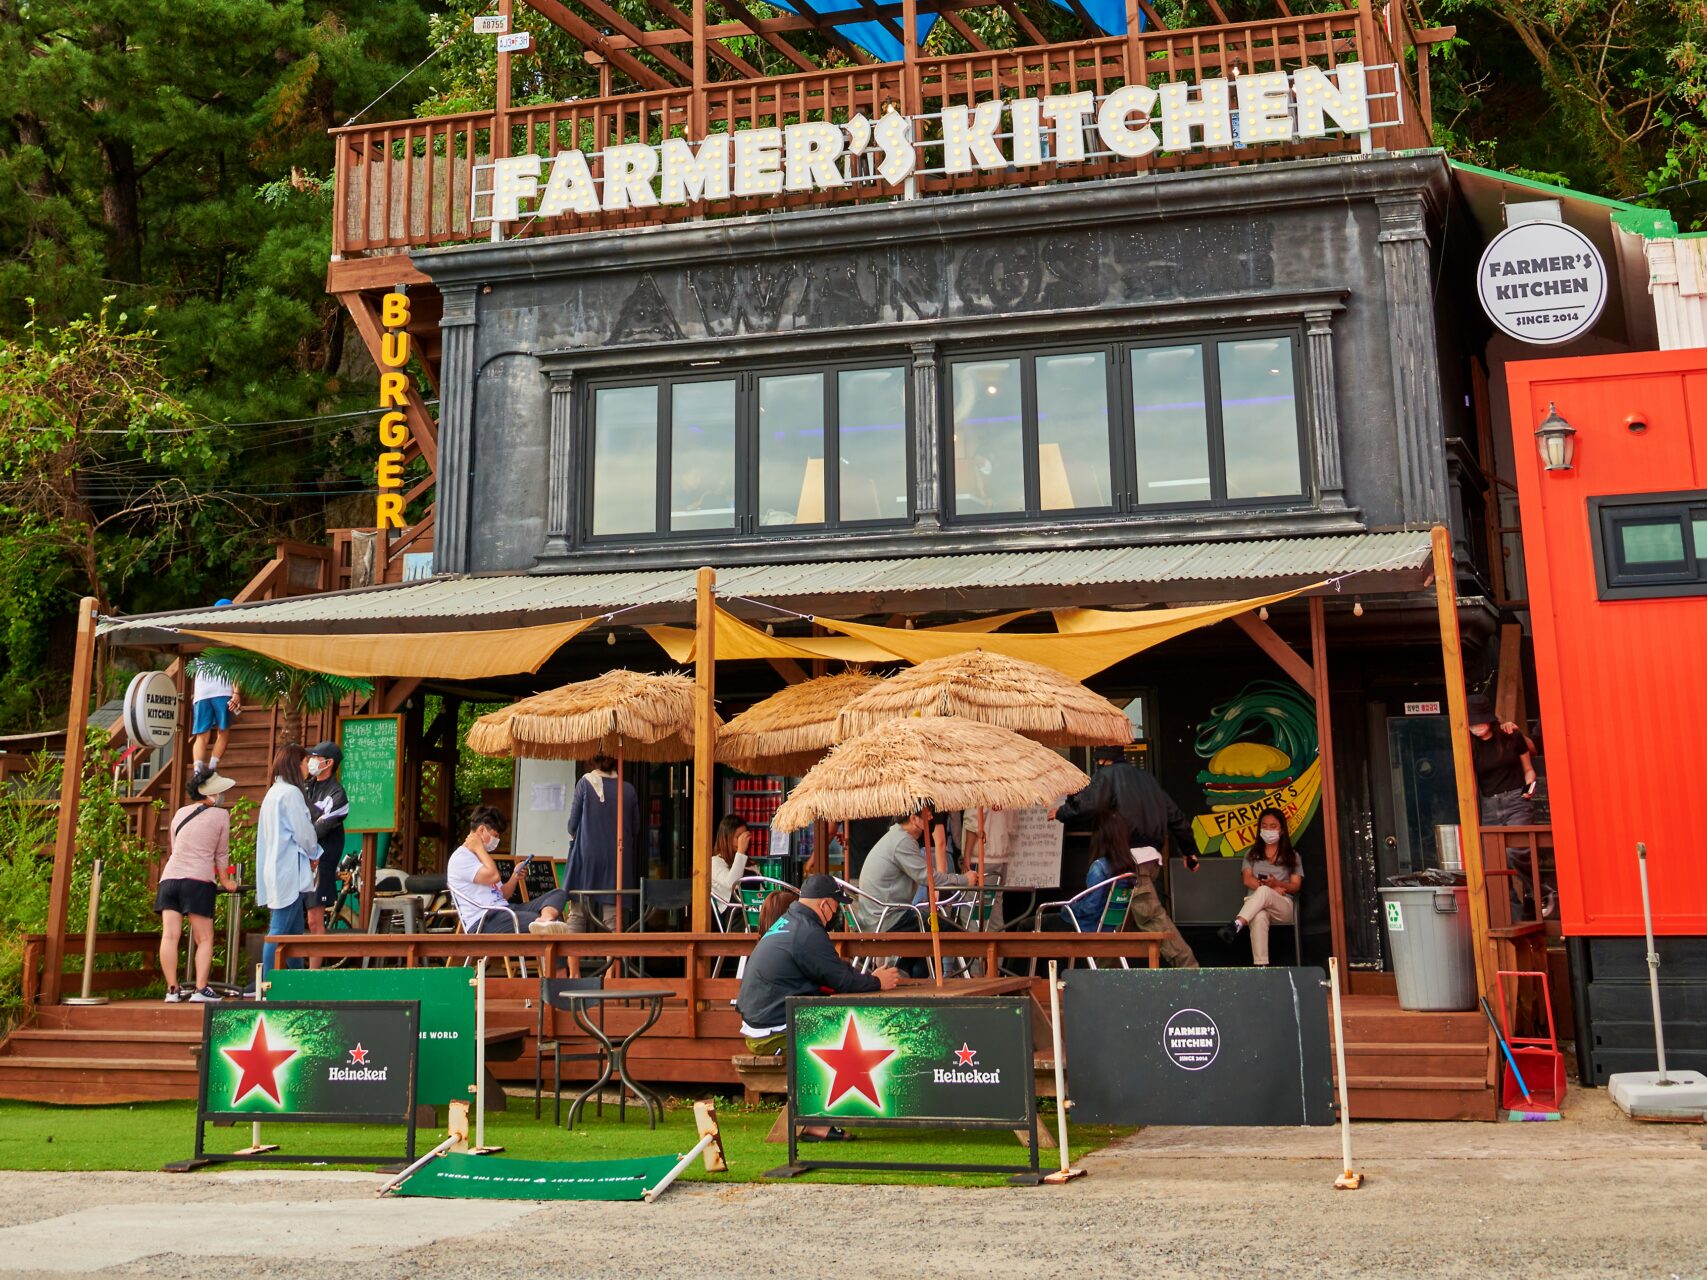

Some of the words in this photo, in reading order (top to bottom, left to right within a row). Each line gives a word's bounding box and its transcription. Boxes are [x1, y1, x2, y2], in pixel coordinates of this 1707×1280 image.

[494, 110, 916, 221] FARMER'S
[941, 61, 1369, 174] KITCHEN
[1489, 253, 1592, 278] FARMER'S
[1496, 278, 1588, 301] KITCHEN
[1516, 315, 1550, 326] SINCE
[1553, 313, 1579, 323] 2014
[377, 293, 411, 529] BURGER
[146, 694, 177, 706] FARMER'S
[147, 709, 175, 720] KITCHEN
[1214, 785, 1298, 832] FARMER'S
[1236, 802, 1298, 846] KIEN
[430, 1031, 459, 1039] WORLD
[1168, 1026, 1216, 1036] FARMER'S
[1171, 1038, 1213, 1048] KITCHEN
[328, 1066, 388, 1080] Heineken
[933, 1068, 1000, 1083] Heineken
